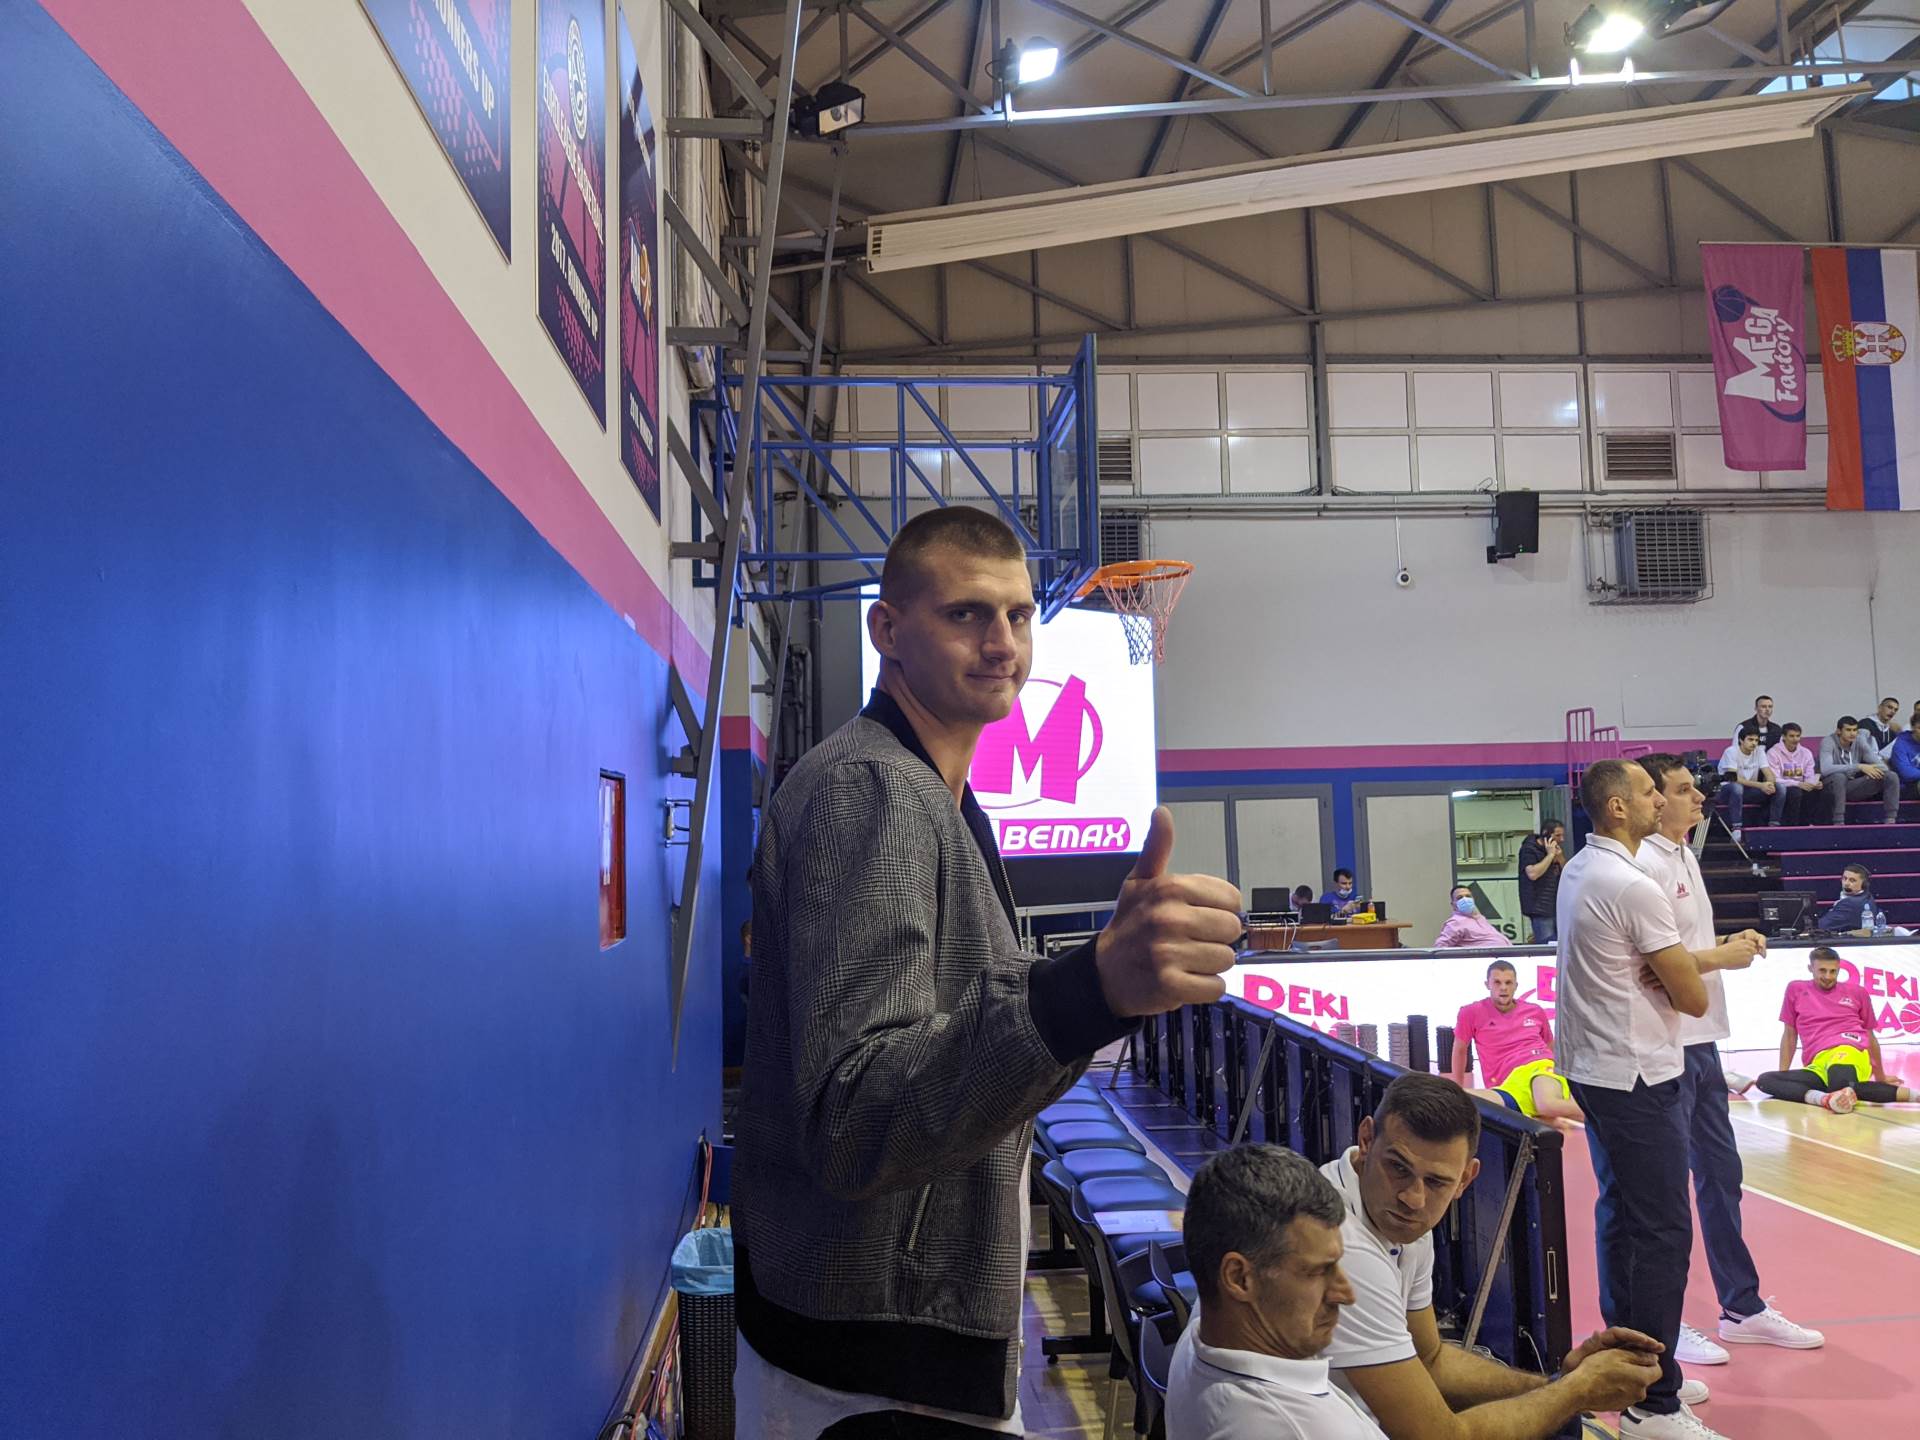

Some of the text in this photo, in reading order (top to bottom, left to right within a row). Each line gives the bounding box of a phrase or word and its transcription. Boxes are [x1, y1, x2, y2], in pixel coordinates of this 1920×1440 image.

[481, 67, 495, 120] UP
[1723, 306, 1779, 403] MEGA
[1774, 316, 1799, 402] Factory
[1002, 823, 1128, 851] BEMAX
[1243, 973, 1350, 1021] DEKI
